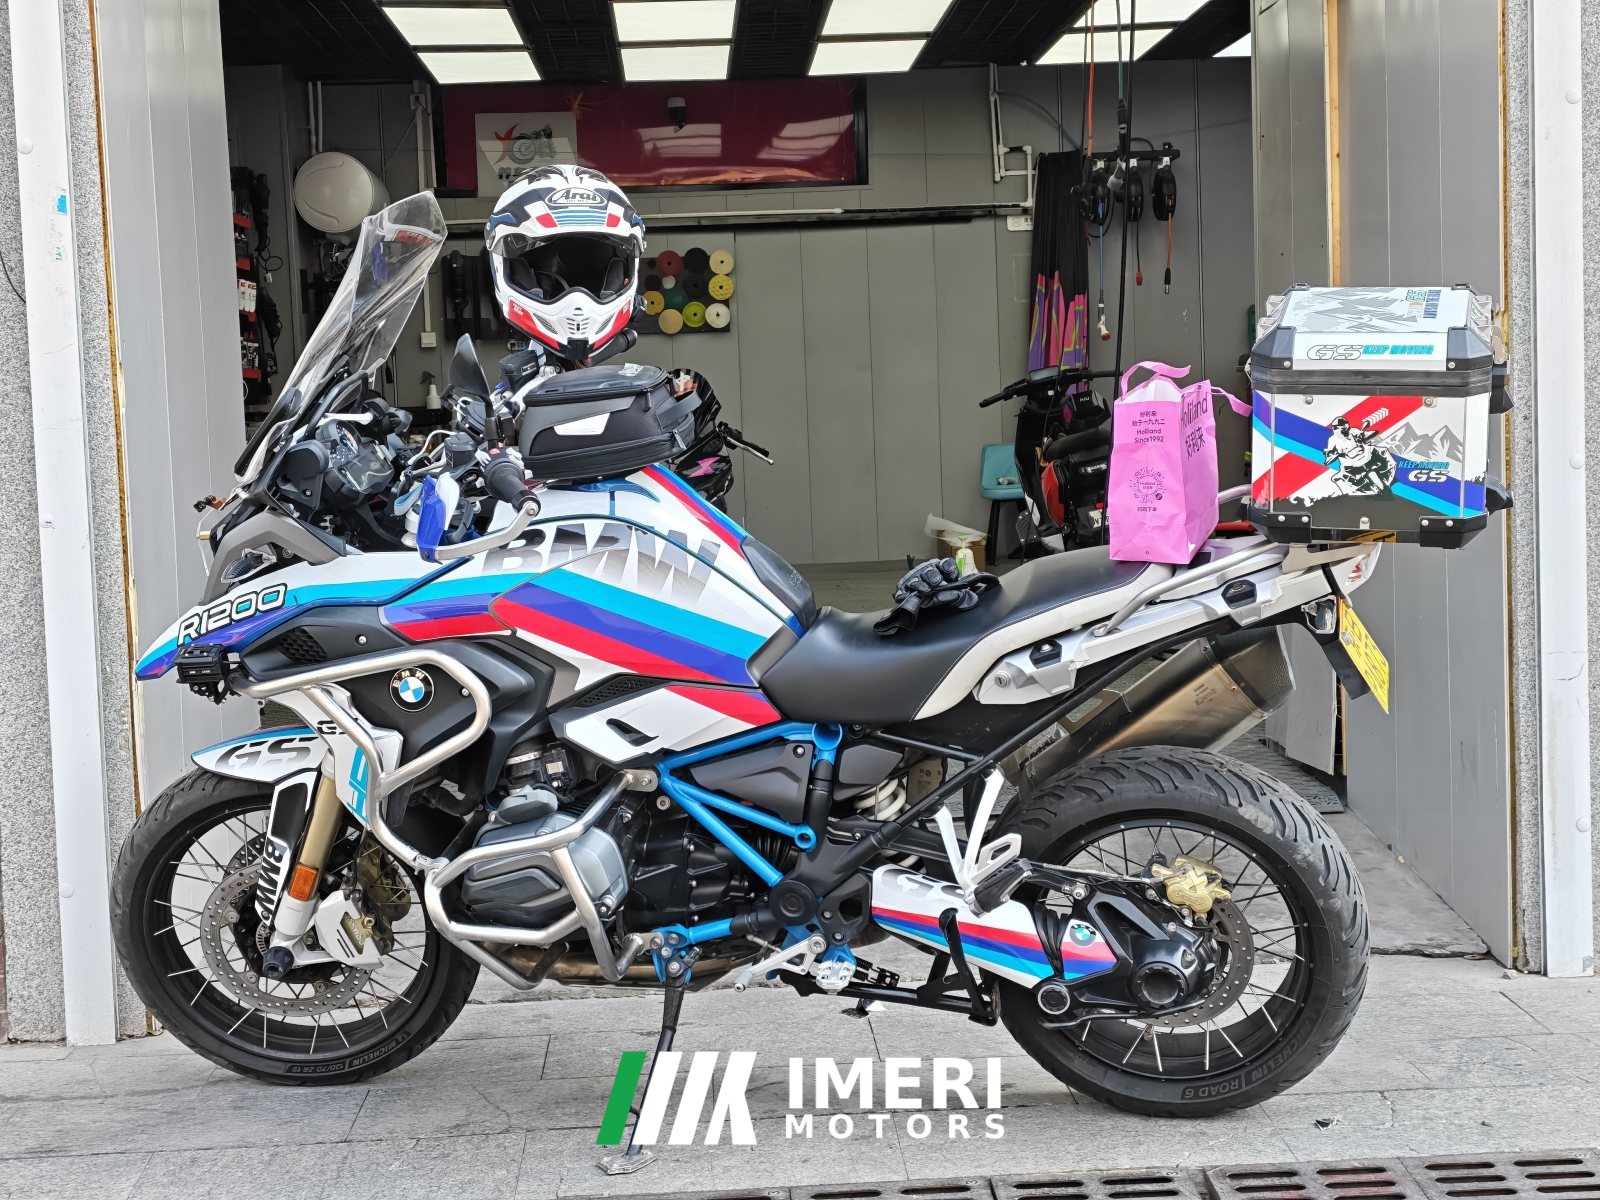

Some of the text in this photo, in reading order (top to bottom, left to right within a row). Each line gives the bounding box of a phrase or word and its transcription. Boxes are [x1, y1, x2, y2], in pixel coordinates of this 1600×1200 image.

[552, 189, 598, 203] Arai
[1306, 344, 1363, 361] GS
[1408, 469, 1449, 482] GS
[482, 522, 721, 606] BMW
[177, 583, 288, 647] R1200
[215, 736, 319, 771] GS
[253, 838, 289, 916] BMW
[352, 1039, 397, 1066] MICHELIN
[316, 1062, 344, 1073] 120/70
[1184, 1087, 1195, 1099] 6
[1199, 1079, 1239, 1097] ROAD
